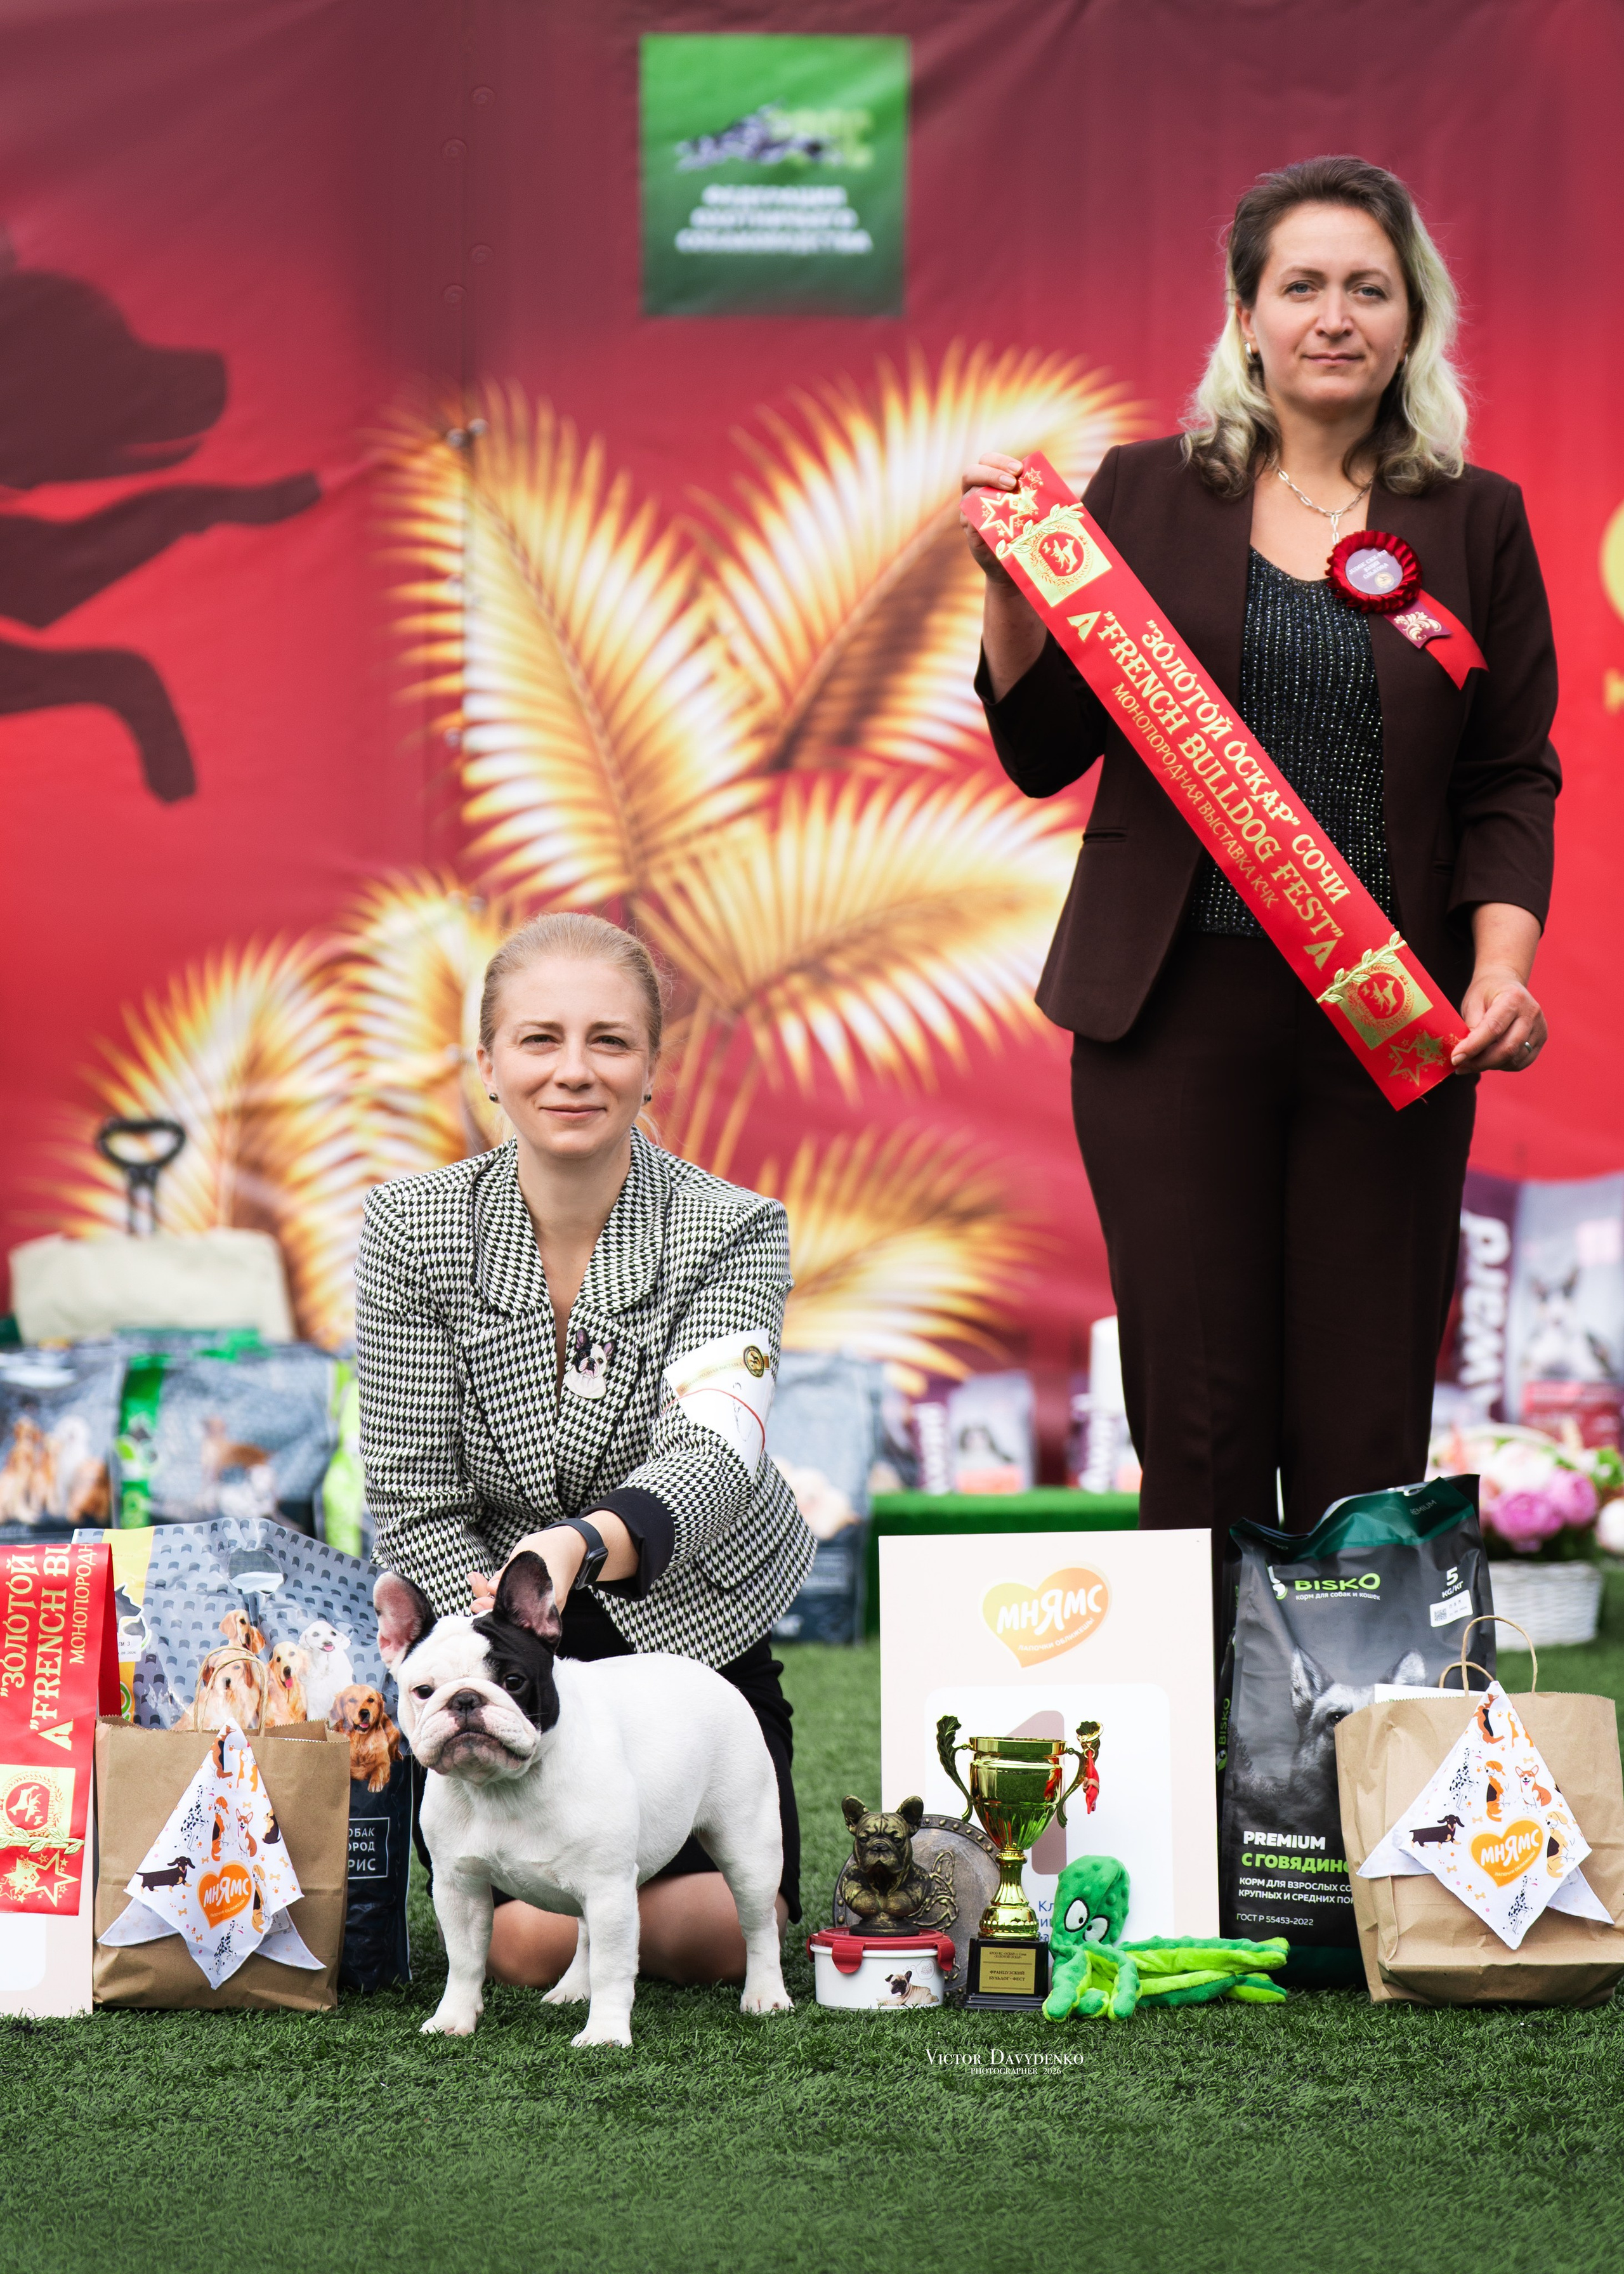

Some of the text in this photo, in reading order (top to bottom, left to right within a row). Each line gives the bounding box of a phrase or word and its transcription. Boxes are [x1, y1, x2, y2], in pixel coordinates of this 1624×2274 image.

[1097, 610, 1345, 938] "FRENCH BULLDOG FEST"
[1111, 681, 1280, 909] МОНОПОРОДНАЯ ВЫСТАВКА КЧК
[1292, 834, 1351, 905] СОЧИ
[1295, 1572, 1381, 1591] BISKO
[1446, 1566, 1458, 1586] 5
[1359, 1592, 1381, 1601] кошек
[997, 1584, 1103, 1636] МНЯМС
[1018, 1641, 1054, 1652] ЛАПОЧКИ
[29, 1586, 67, 1731] "FRENCH
[1218, 1697, 1231, 1745] BISKO
[1243, 1830, 1326, 1850] PREMIUM
[1481, 1829, 1540, 1867] МНЯМС
[1241, 1852, 1253, 1867] С
[203, 1876, 249, 1908] МНЯМС
[1240, 1877, 1265, 1887] КОРМ
[1266, 1879, 1286, 1889] ДЛЯ
[1287, 1881, 1338, 1892] ВЗРОСЛЫХ
[1238, 1889, 1282, 1900] КРУПНЫХ
[1283, 1893, 1290, 1901] И
[1292, 1893, 1335, 1903] СРЕДНИХ
[1237, 1912, 1257, 1922] ГОСТ
[1266, 1916, 1314, 1926] 55453-2022
